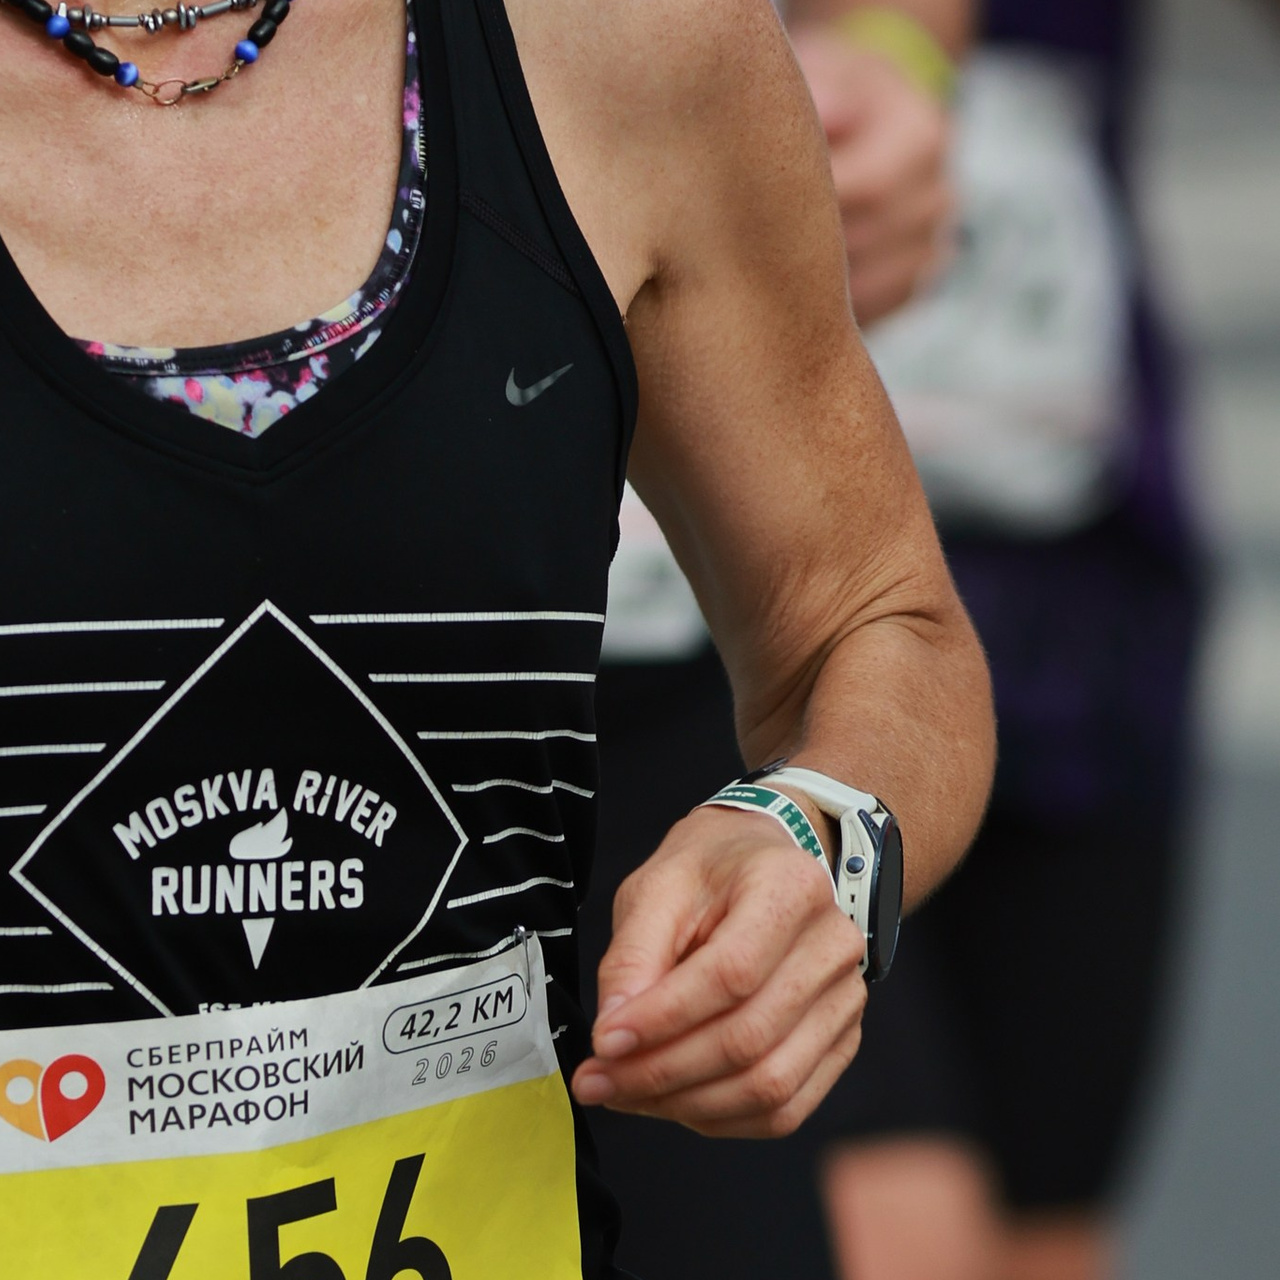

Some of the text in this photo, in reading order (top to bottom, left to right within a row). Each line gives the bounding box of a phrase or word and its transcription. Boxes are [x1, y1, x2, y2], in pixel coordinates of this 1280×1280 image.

[112, 767, 398, 860] MOSKVA RIVER
[151, 857, 364, 916] RUNNERS
[399, 1001, 462, 1040] 42,2
[126, 1027, 309, 1068] СБЕРПРАЙМ
[127, 1040, 365, 1101] МОСКОВСКИЙ
[411, 1040, 498, 1086] 2026
[129, 1089, 310, 1135] МАРАФОН
